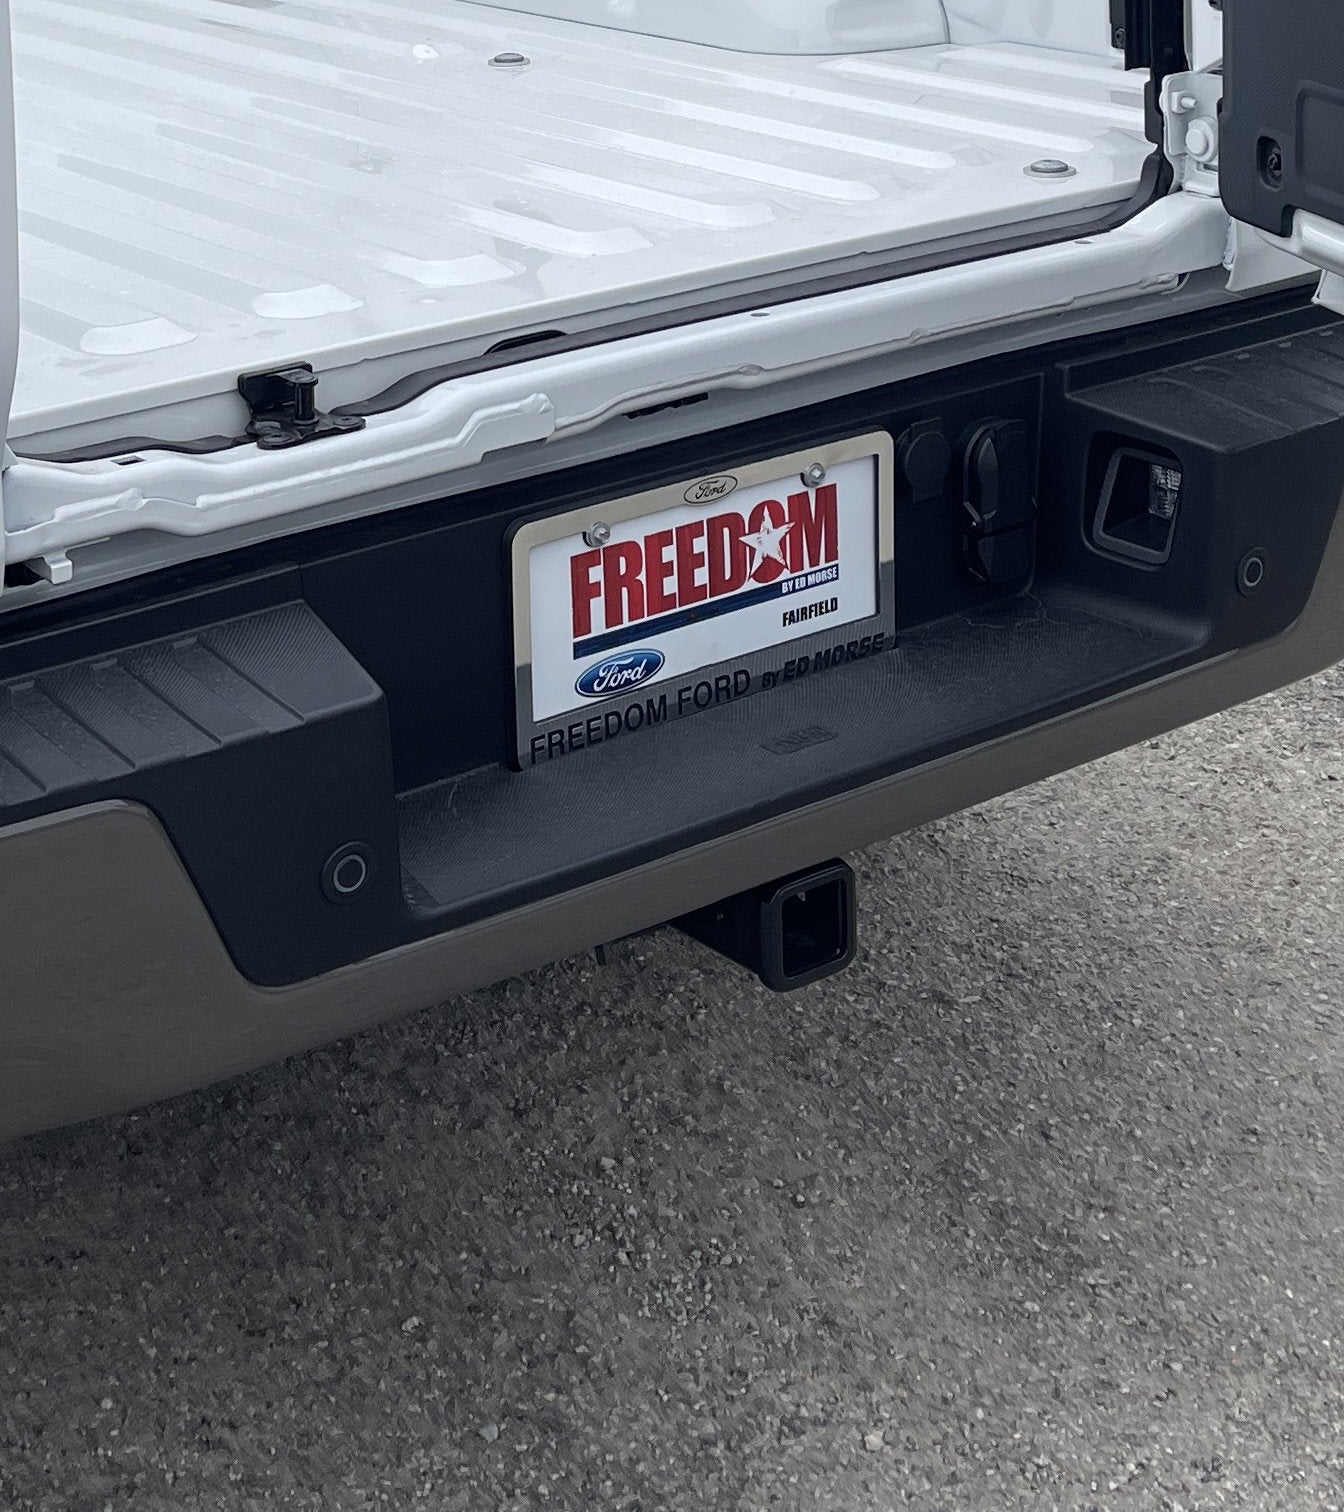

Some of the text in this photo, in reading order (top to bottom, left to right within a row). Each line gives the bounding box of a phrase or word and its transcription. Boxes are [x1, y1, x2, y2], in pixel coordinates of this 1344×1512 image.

[694, 479, 727, 500] Ford
[570, 483, 838, 638] FREEDOM
[781, 566, 838, 594] BY ED MORSE
[782, 597, 838, 627] FAIRFIELD
[593, 654, 647, 691] Ford
[529, 693, 668, 765] FREEDOM
[677, 668, 751, 716] FORD
[783, 656, 810, 681] ED
[812, 632, 885, 673] MORSE
